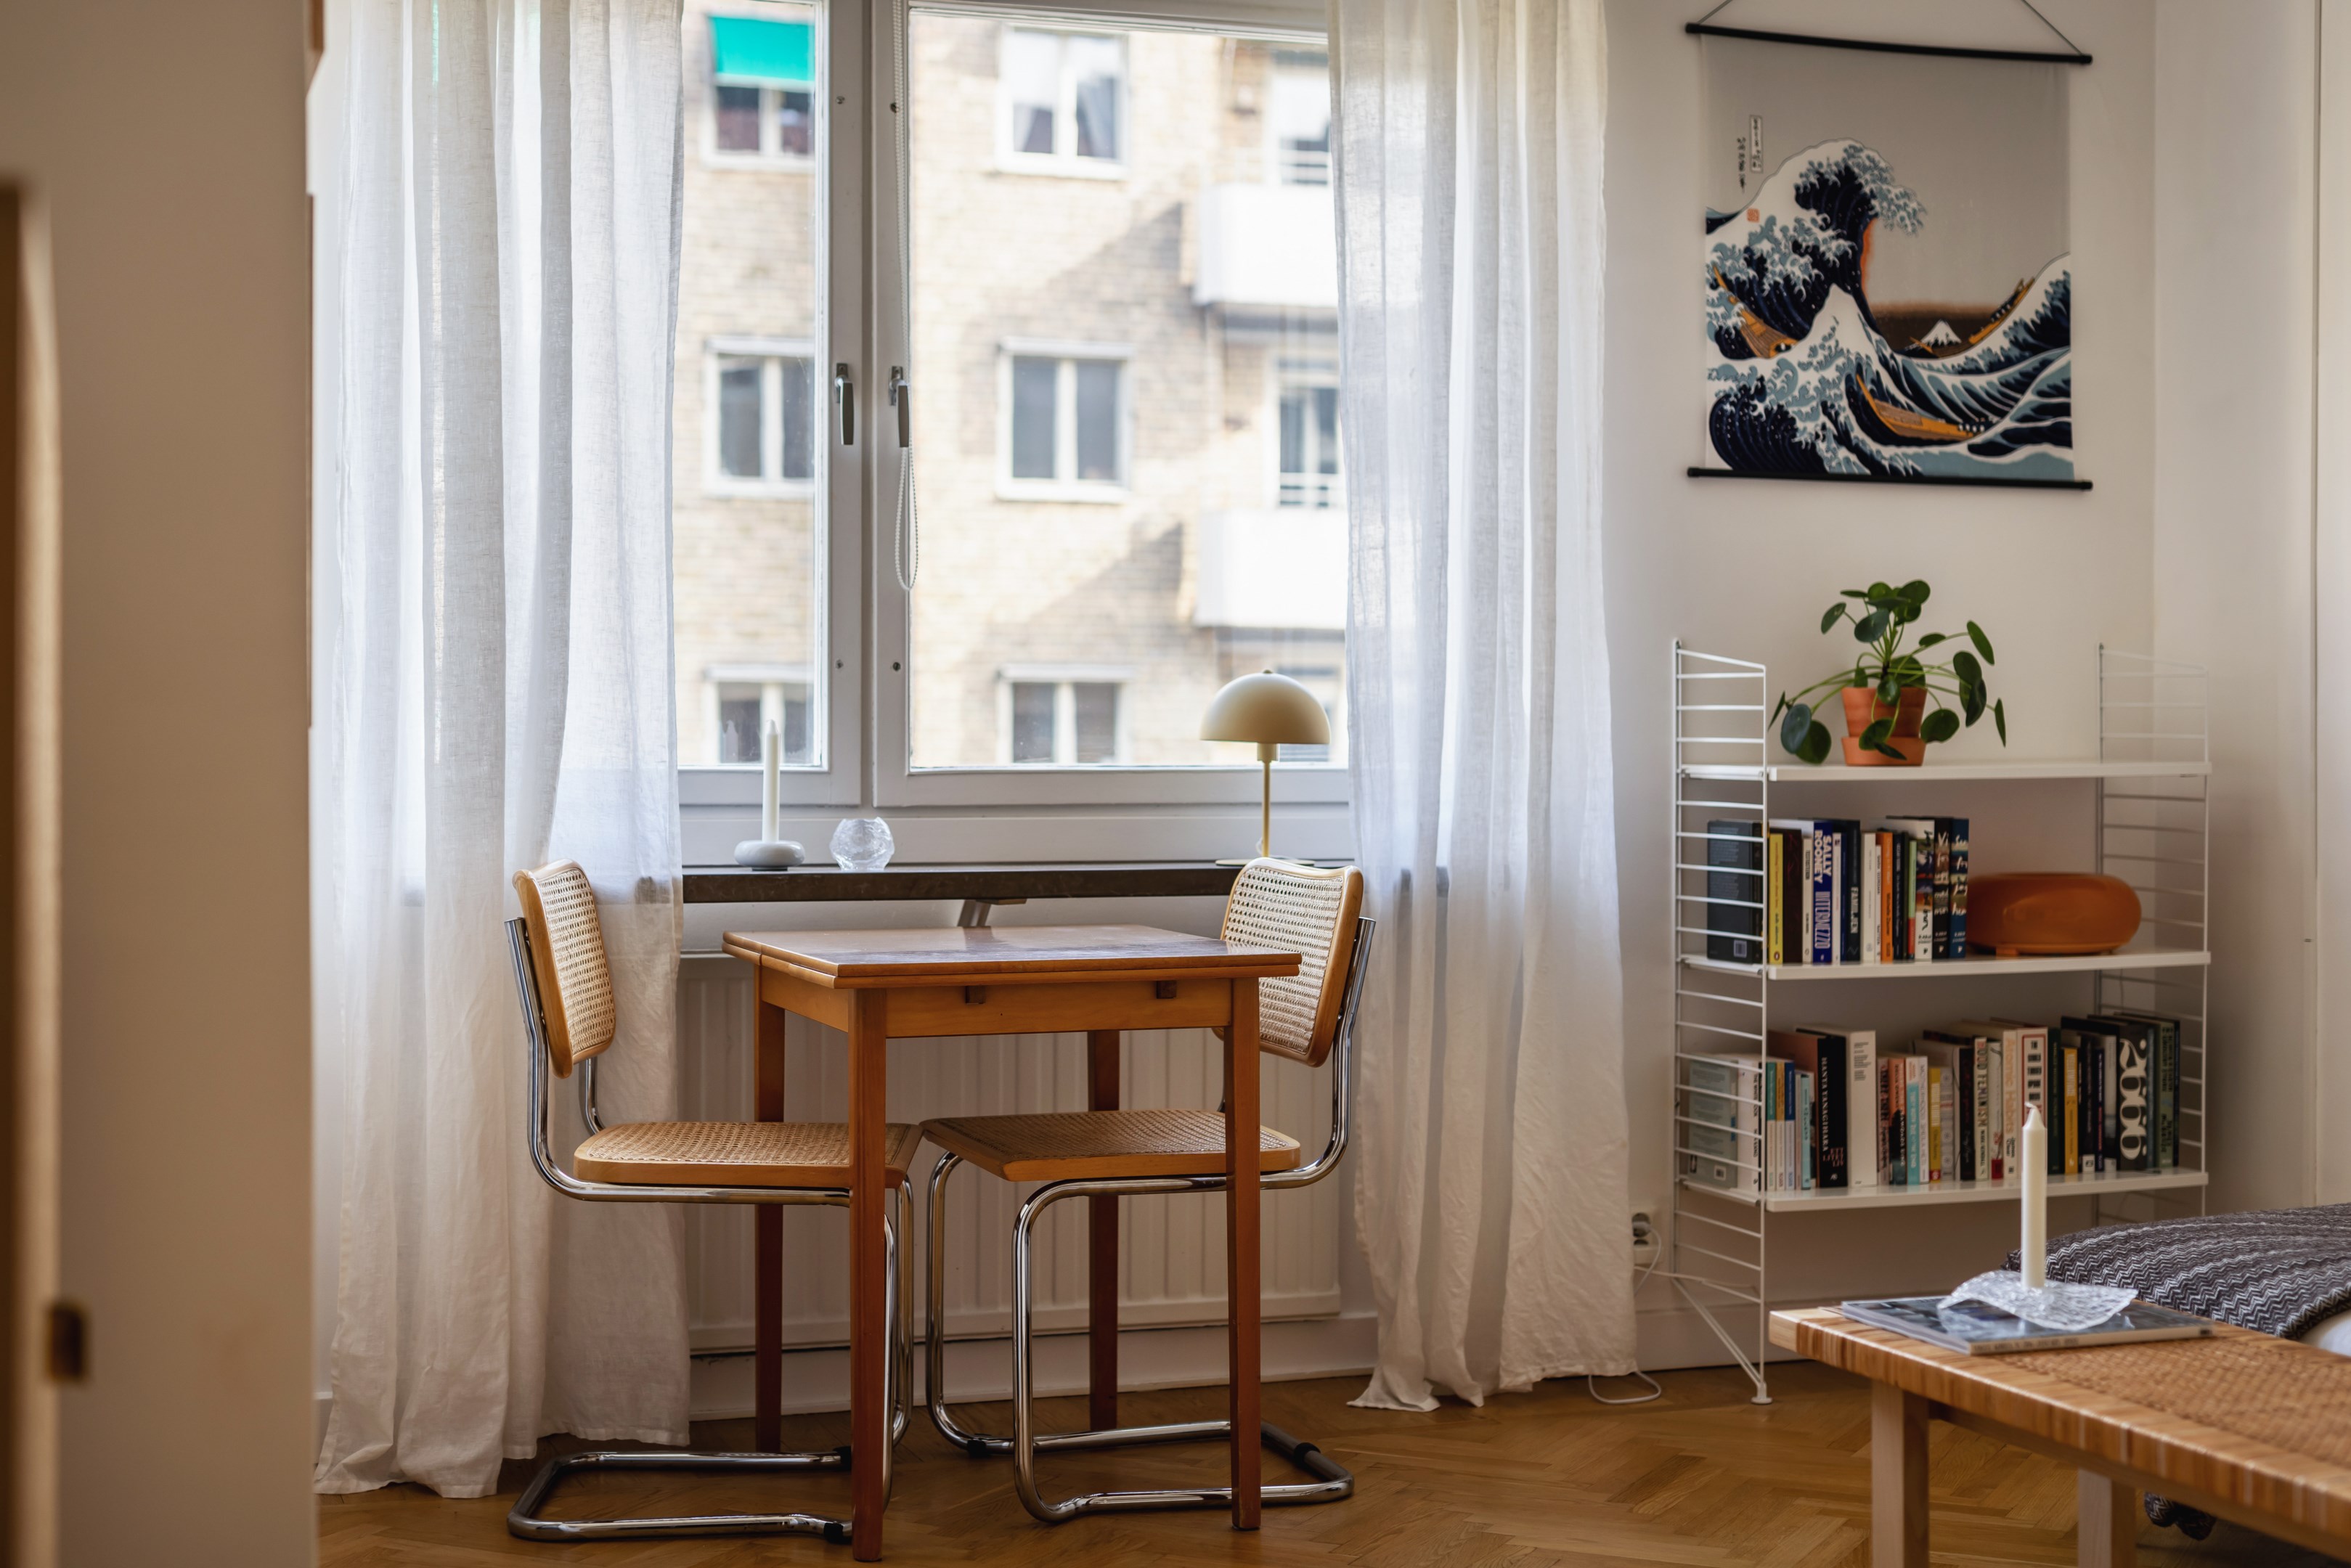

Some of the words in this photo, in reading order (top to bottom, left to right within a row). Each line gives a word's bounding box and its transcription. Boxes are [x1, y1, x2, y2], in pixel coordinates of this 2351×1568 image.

[1814, 830, 1823, 883] ROONEY
[1822, 835, 1832, 877] SALLY
[1814, 891, 1830, 949] INTERMEZZO
[1850, 887, 1859, 934] FAMILJEN
[2005, 1039, 2016, 1087] Atomic
[1977, 1074, 1987, 1127] FEMINISM
[2005, 1090, 2016, 1134] Habits
[2119, 1038, 2148, 1160] 2666
